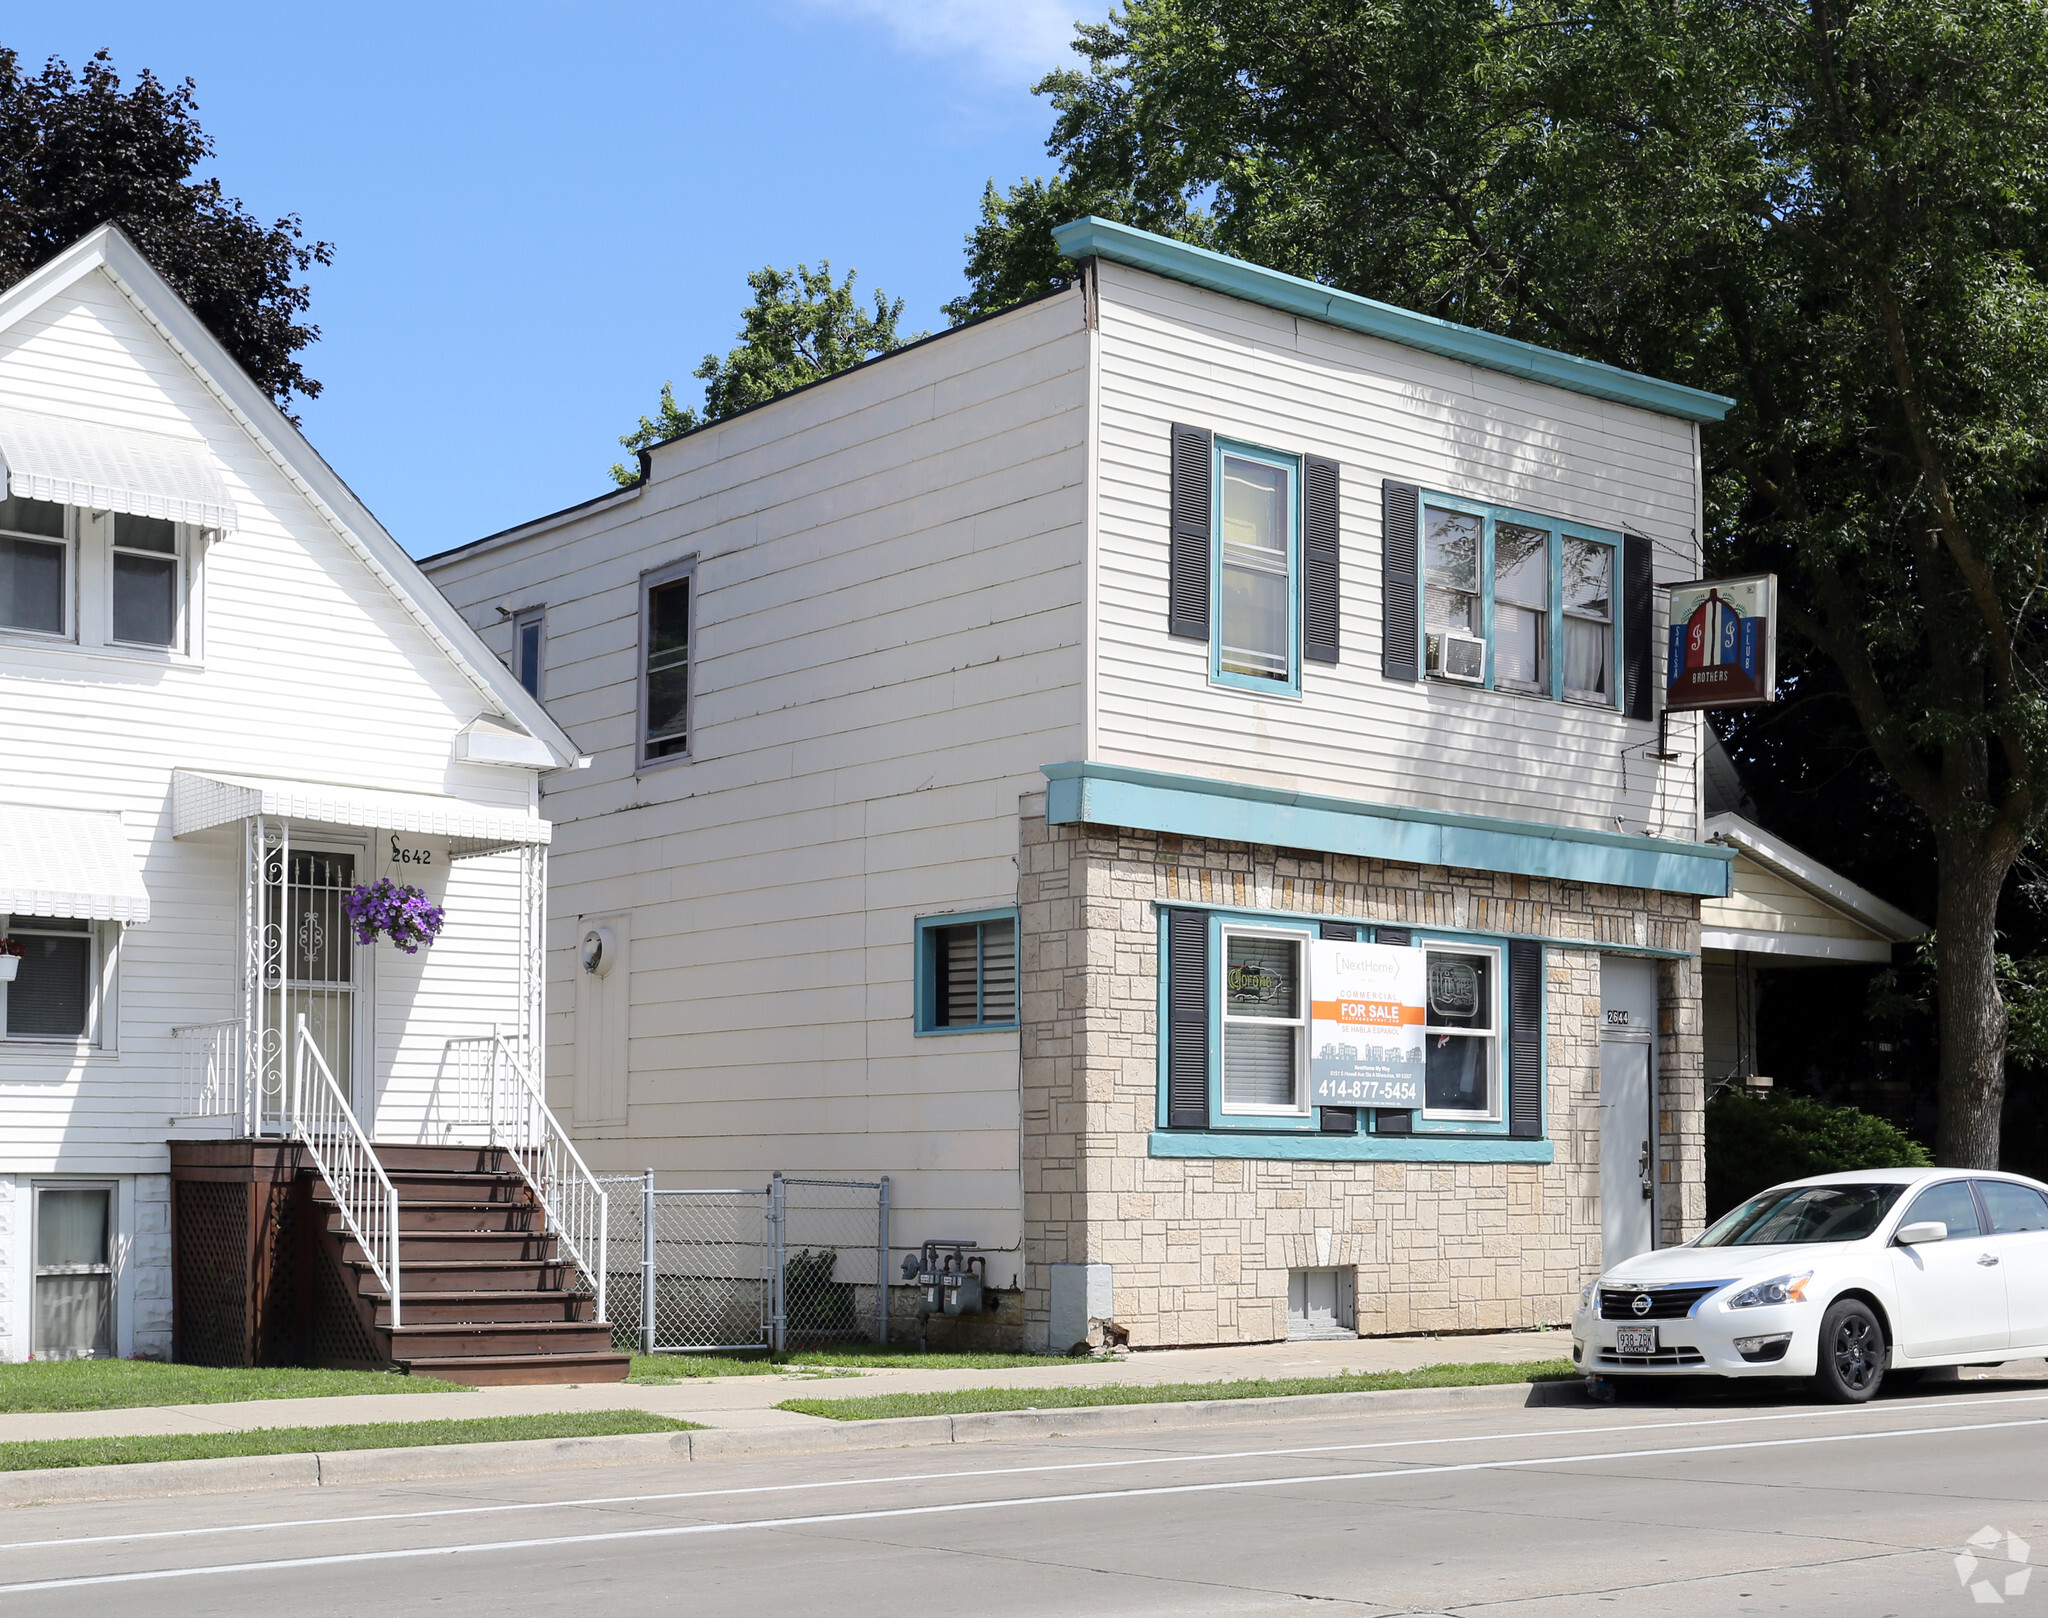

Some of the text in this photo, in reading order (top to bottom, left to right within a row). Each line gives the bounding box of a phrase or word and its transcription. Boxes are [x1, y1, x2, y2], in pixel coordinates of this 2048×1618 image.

[393, 847, 431, 865] 2642
[1341, 958, 1394, 974] NextHome
[1229, 969, 1273, 991] Corona
[1340, 990, 1398, 1001] COMMERCIAL
[1341, 1003, 1400, 1019] FOR SALE
[1608, 1011, 1628, 1024] 2644
[1341, 1025, 1350, 1033] SE
[1351, 1026, 1372, 1034] HABLA
[1319, 1079, 1417, 1100] 414-877-5454
[1620, 1333, 1652, 1347] 938-ZBK
